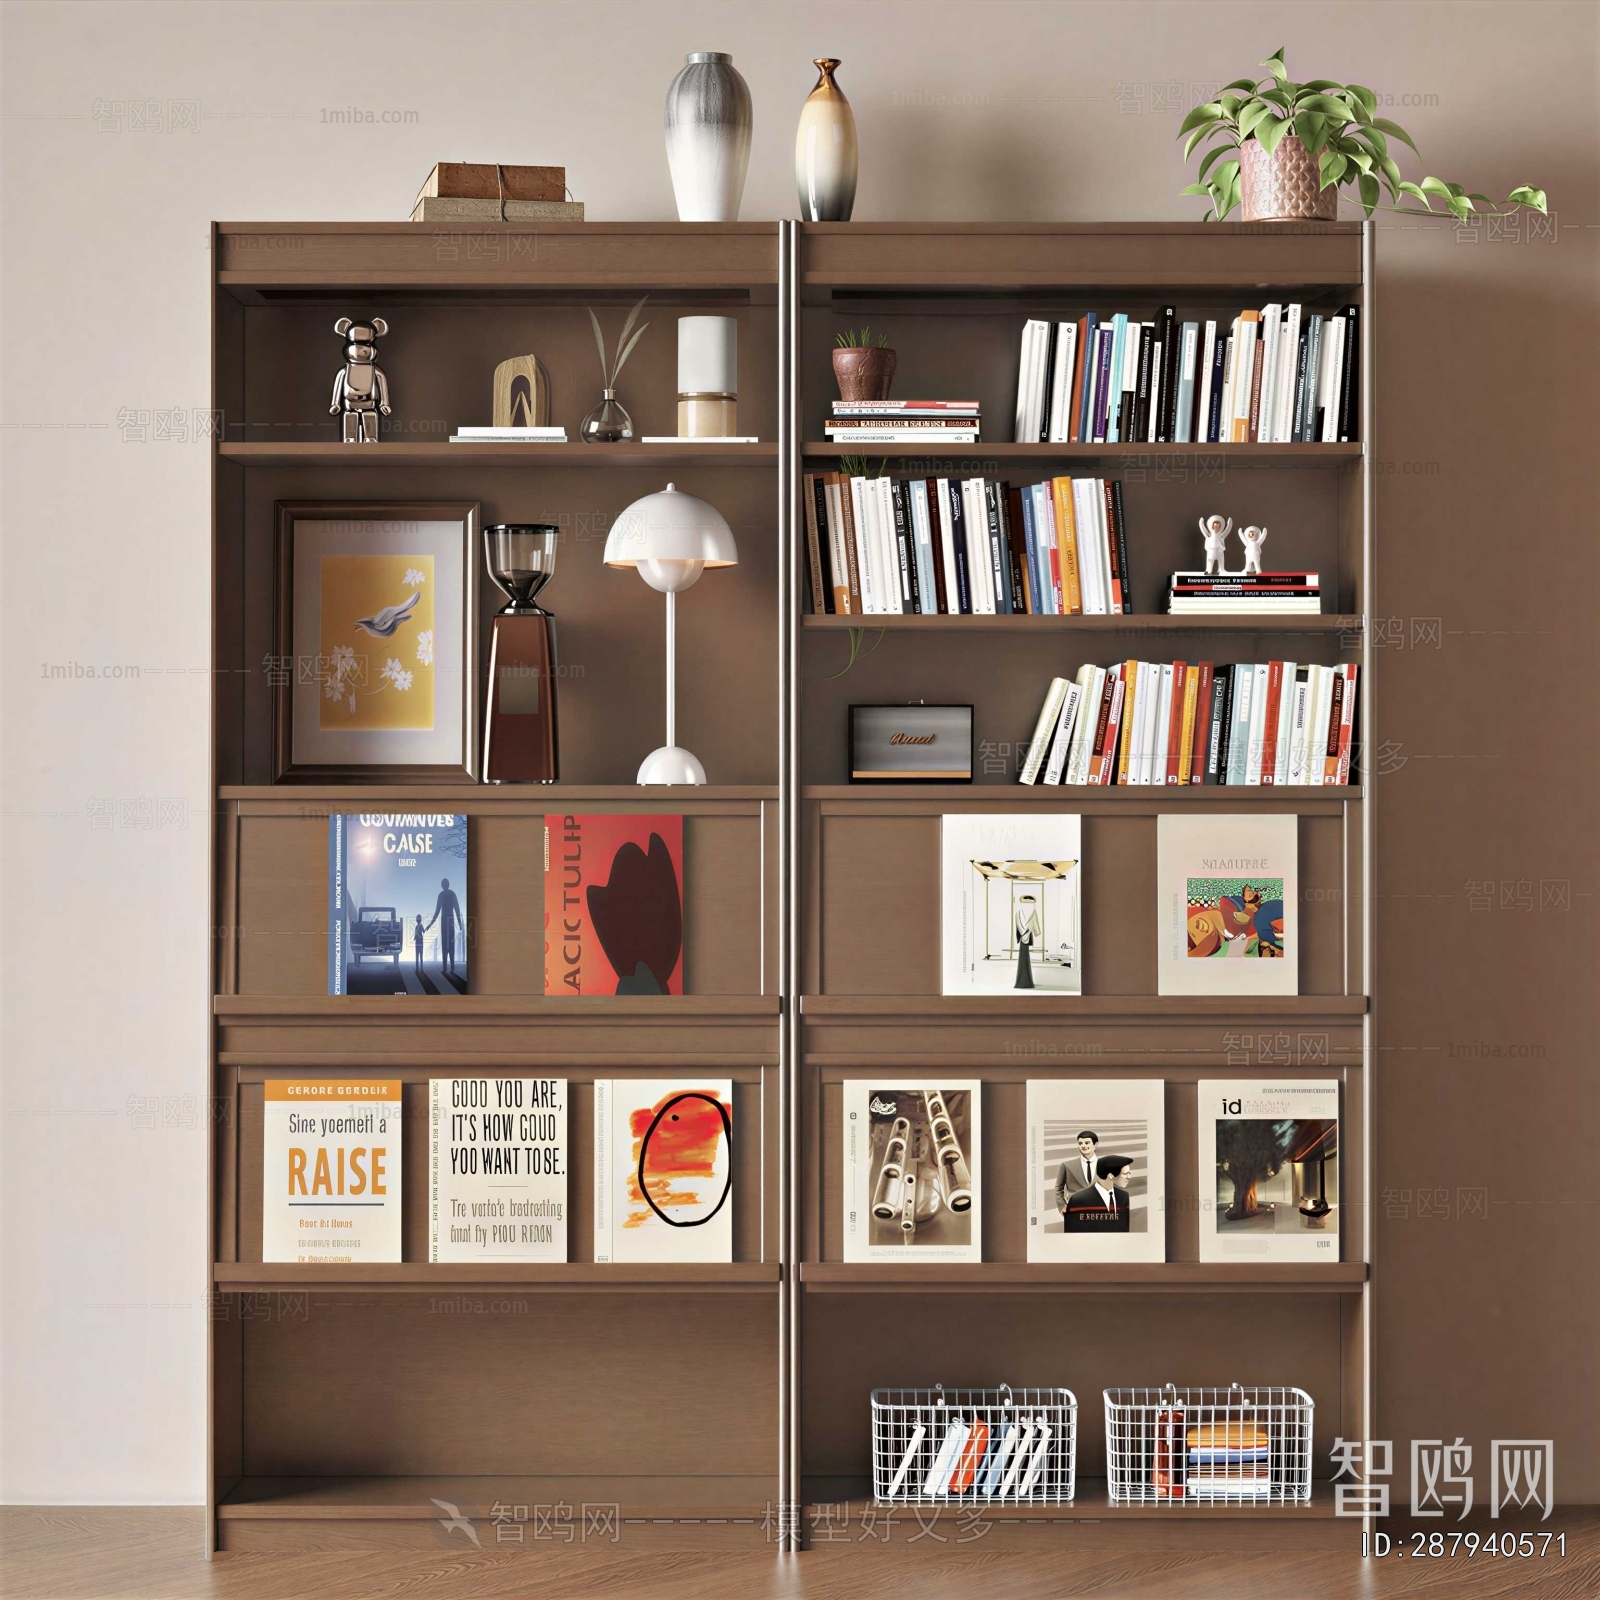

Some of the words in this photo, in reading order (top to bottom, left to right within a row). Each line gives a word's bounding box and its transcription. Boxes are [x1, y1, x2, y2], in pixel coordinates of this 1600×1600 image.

[1222, 1098, 1242, 1115] id
[379, 1118, 387, 1133] a
[452, 1114, 477, 1141] IT'S
[483, 1114, 513, 1141] HOW
[288, 1147, 387, 1196] RAISE
[482, 1147, 520, 1175] WANT
